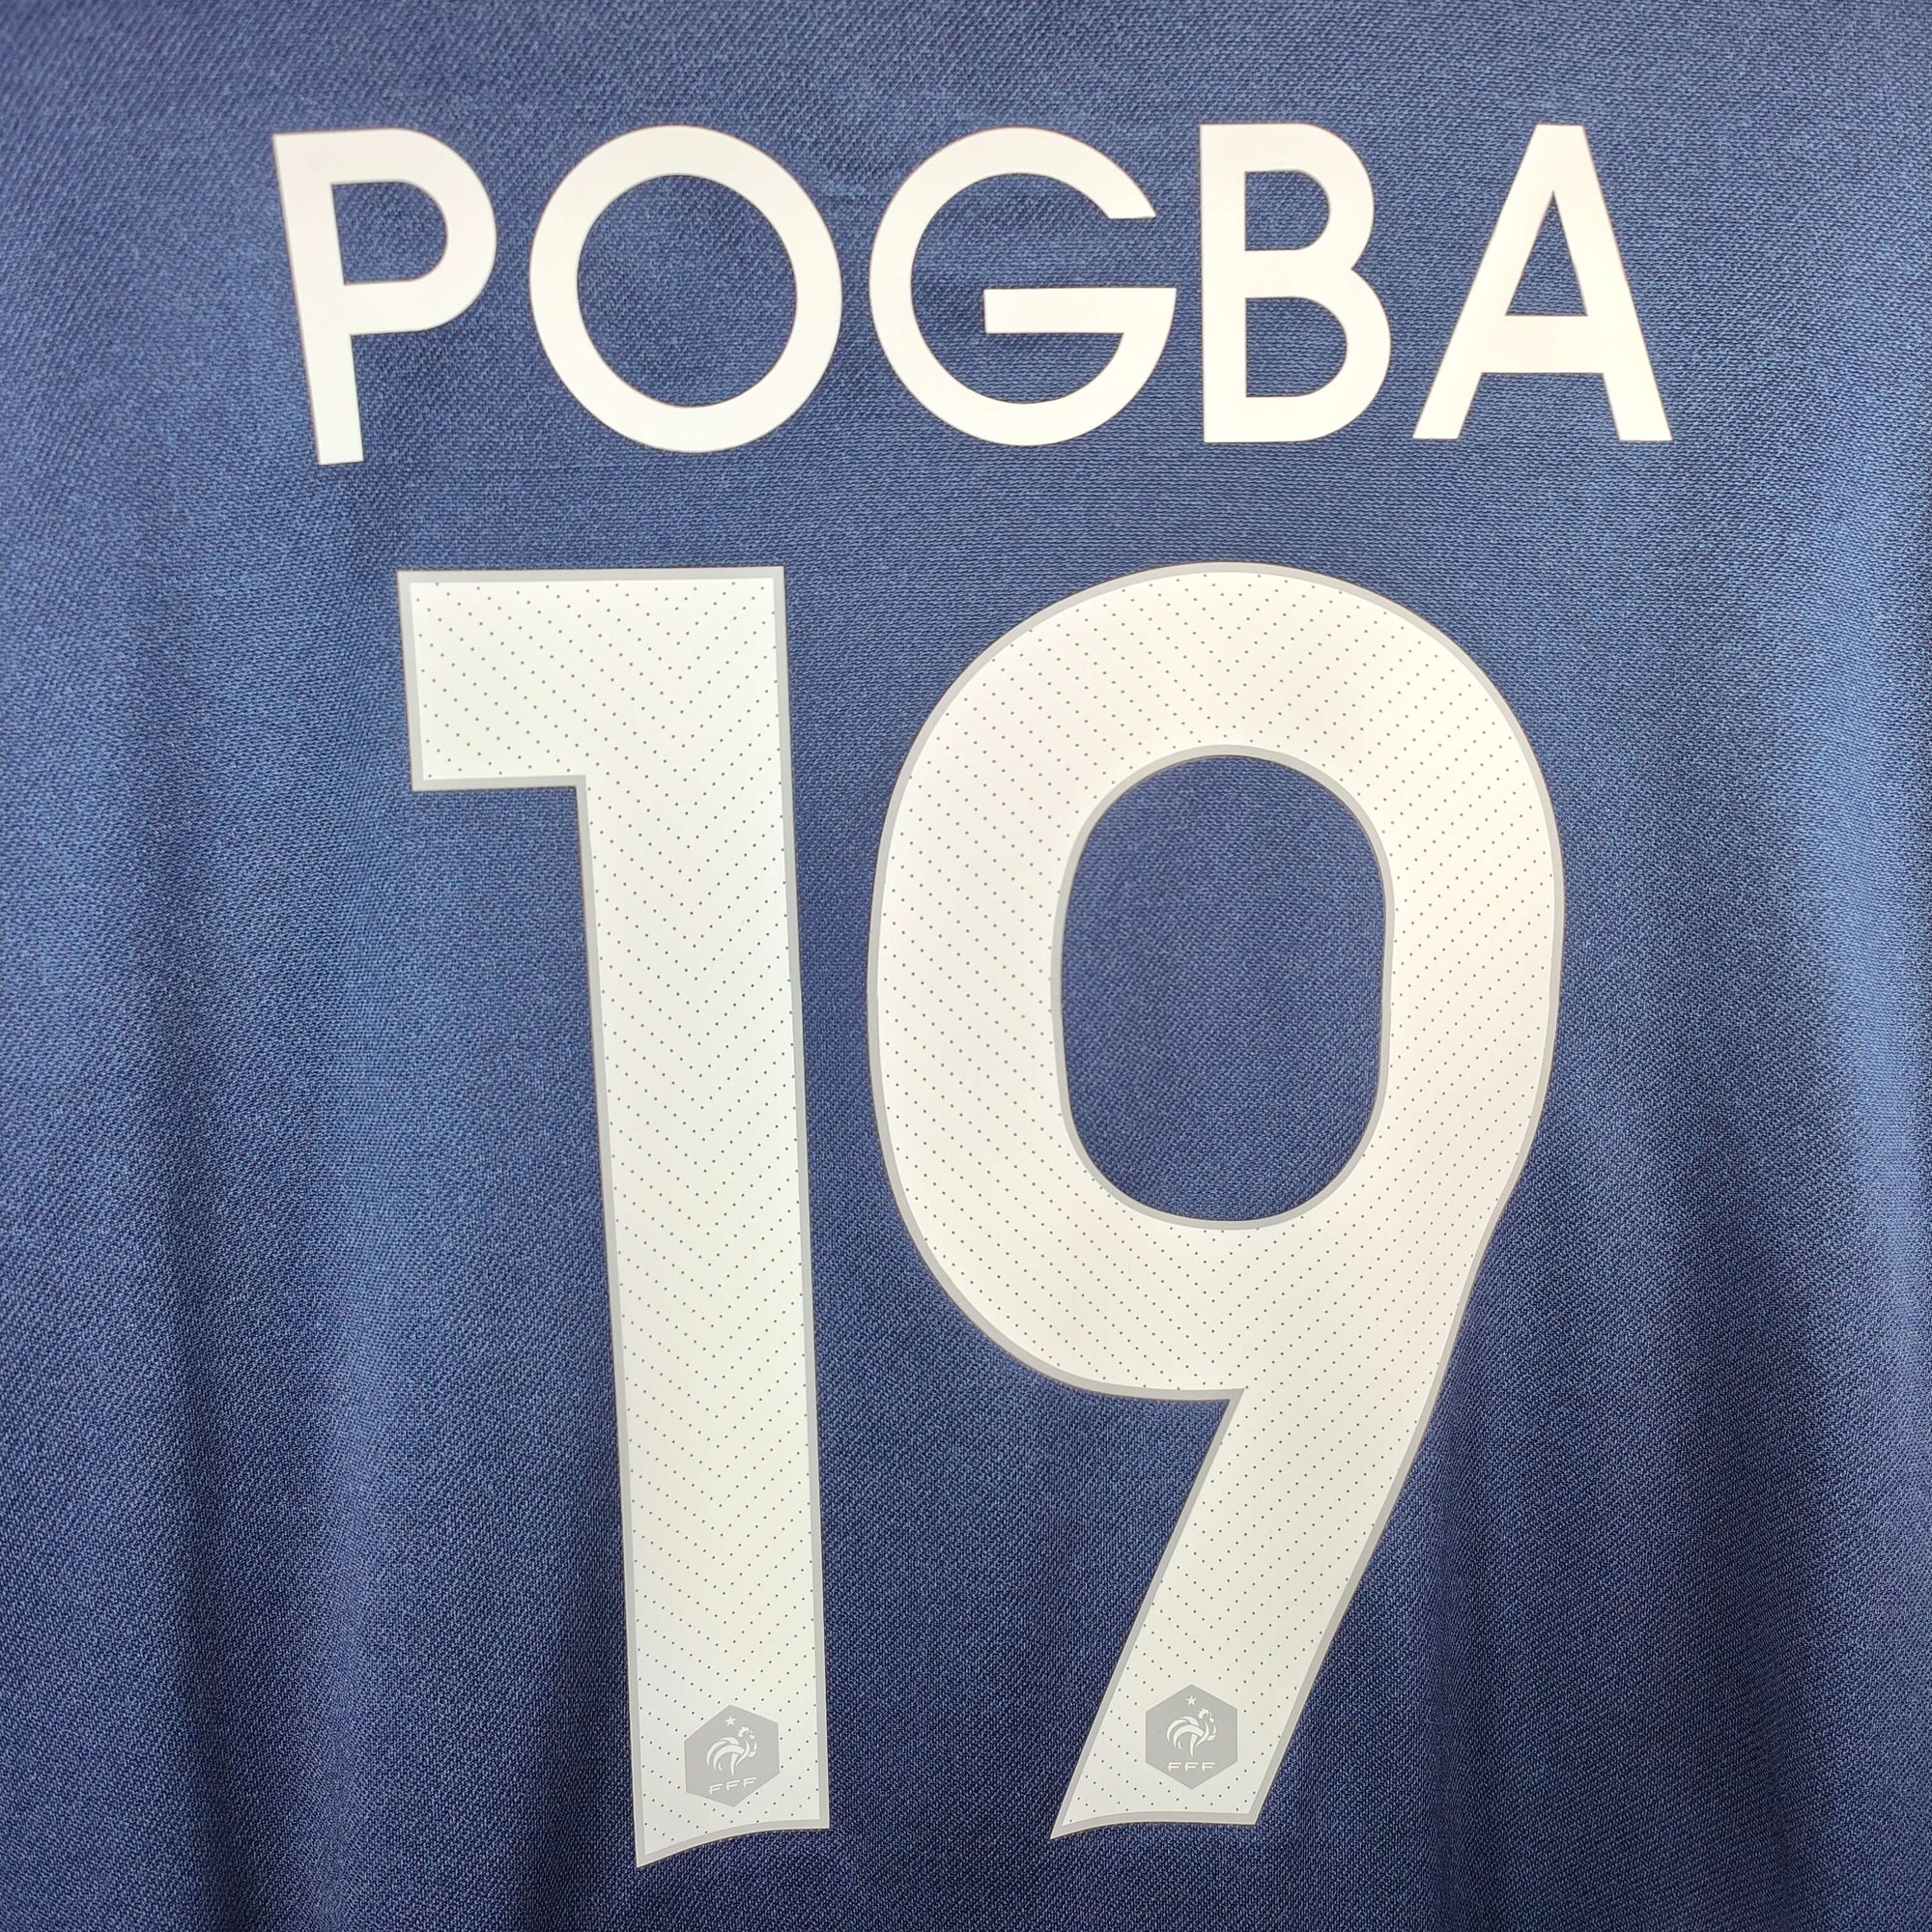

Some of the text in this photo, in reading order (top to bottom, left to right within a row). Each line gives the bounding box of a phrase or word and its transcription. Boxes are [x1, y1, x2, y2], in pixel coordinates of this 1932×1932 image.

[271, 121, 1673, 465] POGBA
[396, 562, 1566, 1867] 19
[709, 1776, 757, 1795] FFF
[1168, 1761, 1216, 1773] FFF
